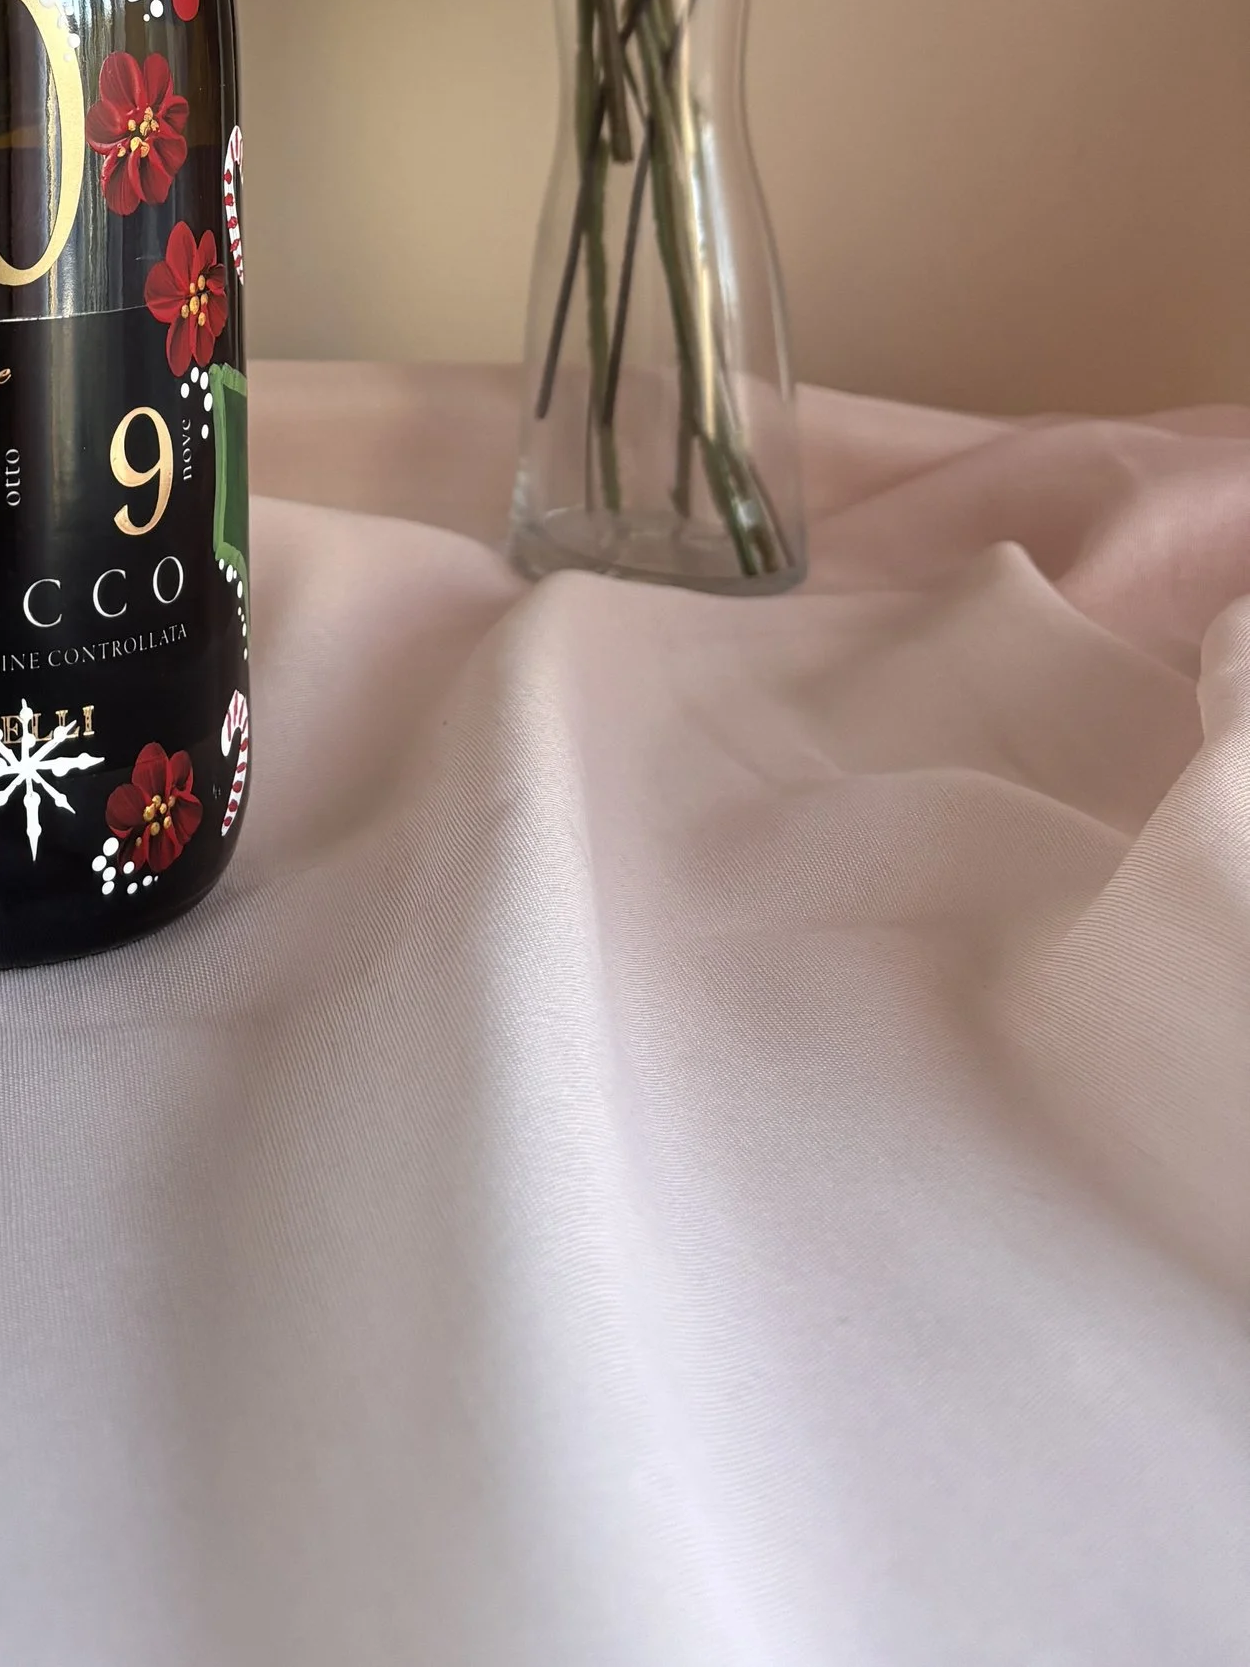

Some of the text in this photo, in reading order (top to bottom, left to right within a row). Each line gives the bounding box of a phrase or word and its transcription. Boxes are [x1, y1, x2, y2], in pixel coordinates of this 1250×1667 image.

[4, 448, 21, 507] otto
[110, 406, 174, 536] 9
[181, 418, 193, 481] nove
[47, 623, 188, 668] CONTROLLATA
